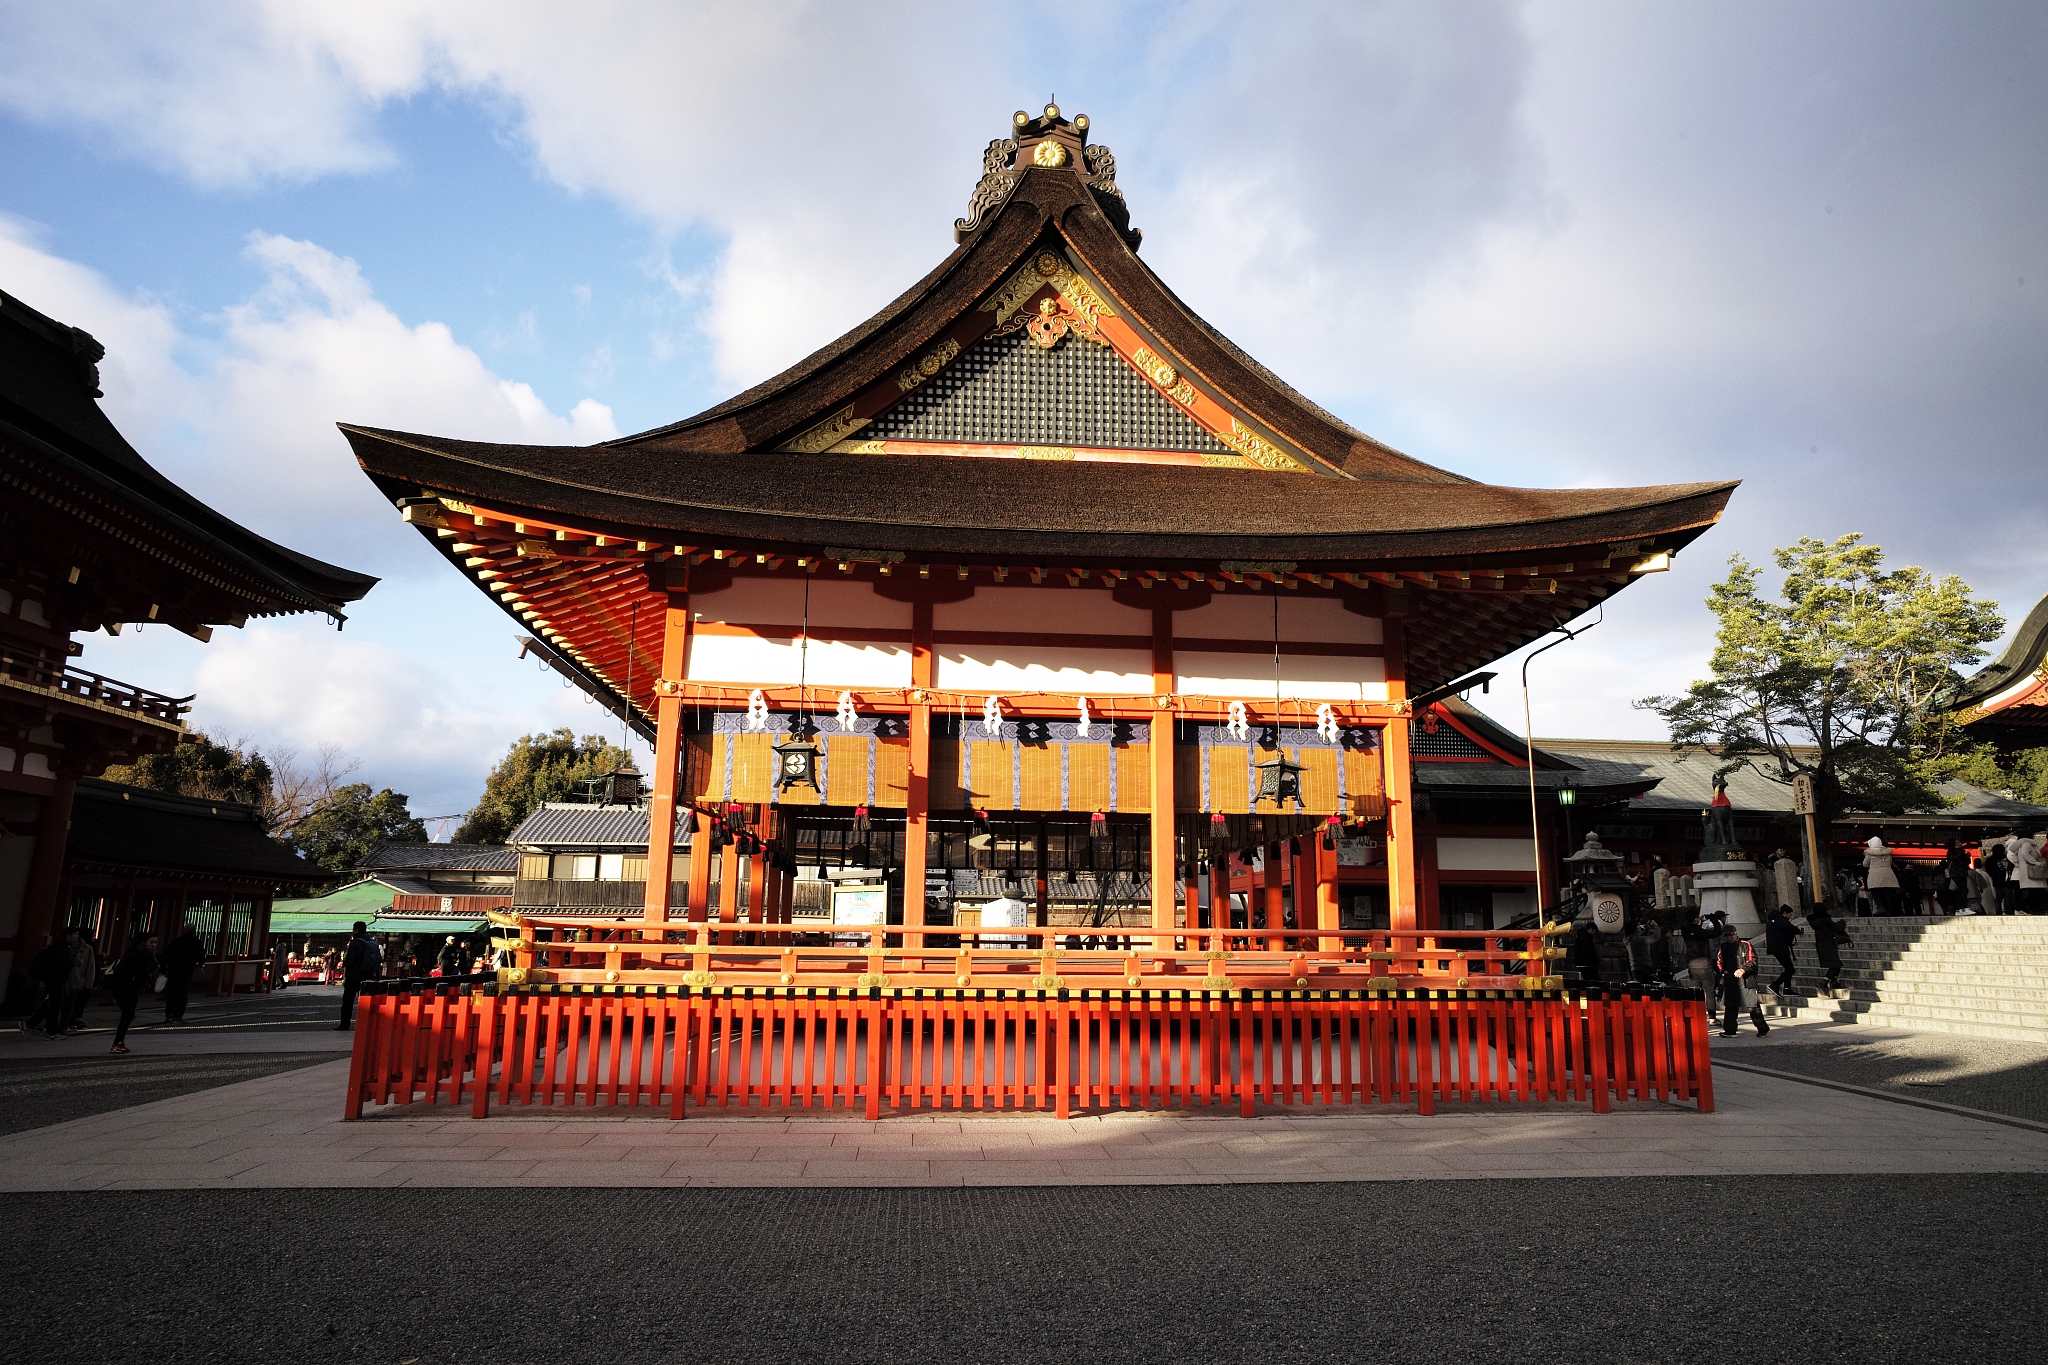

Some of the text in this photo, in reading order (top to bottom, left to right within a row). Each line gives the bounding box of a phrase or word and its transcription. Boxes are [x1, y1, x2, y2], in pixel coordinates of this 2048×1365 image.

[1797, 778, 1807, 811] 初午大祭
[1598, 826, 1651, 838] 朱印受付
